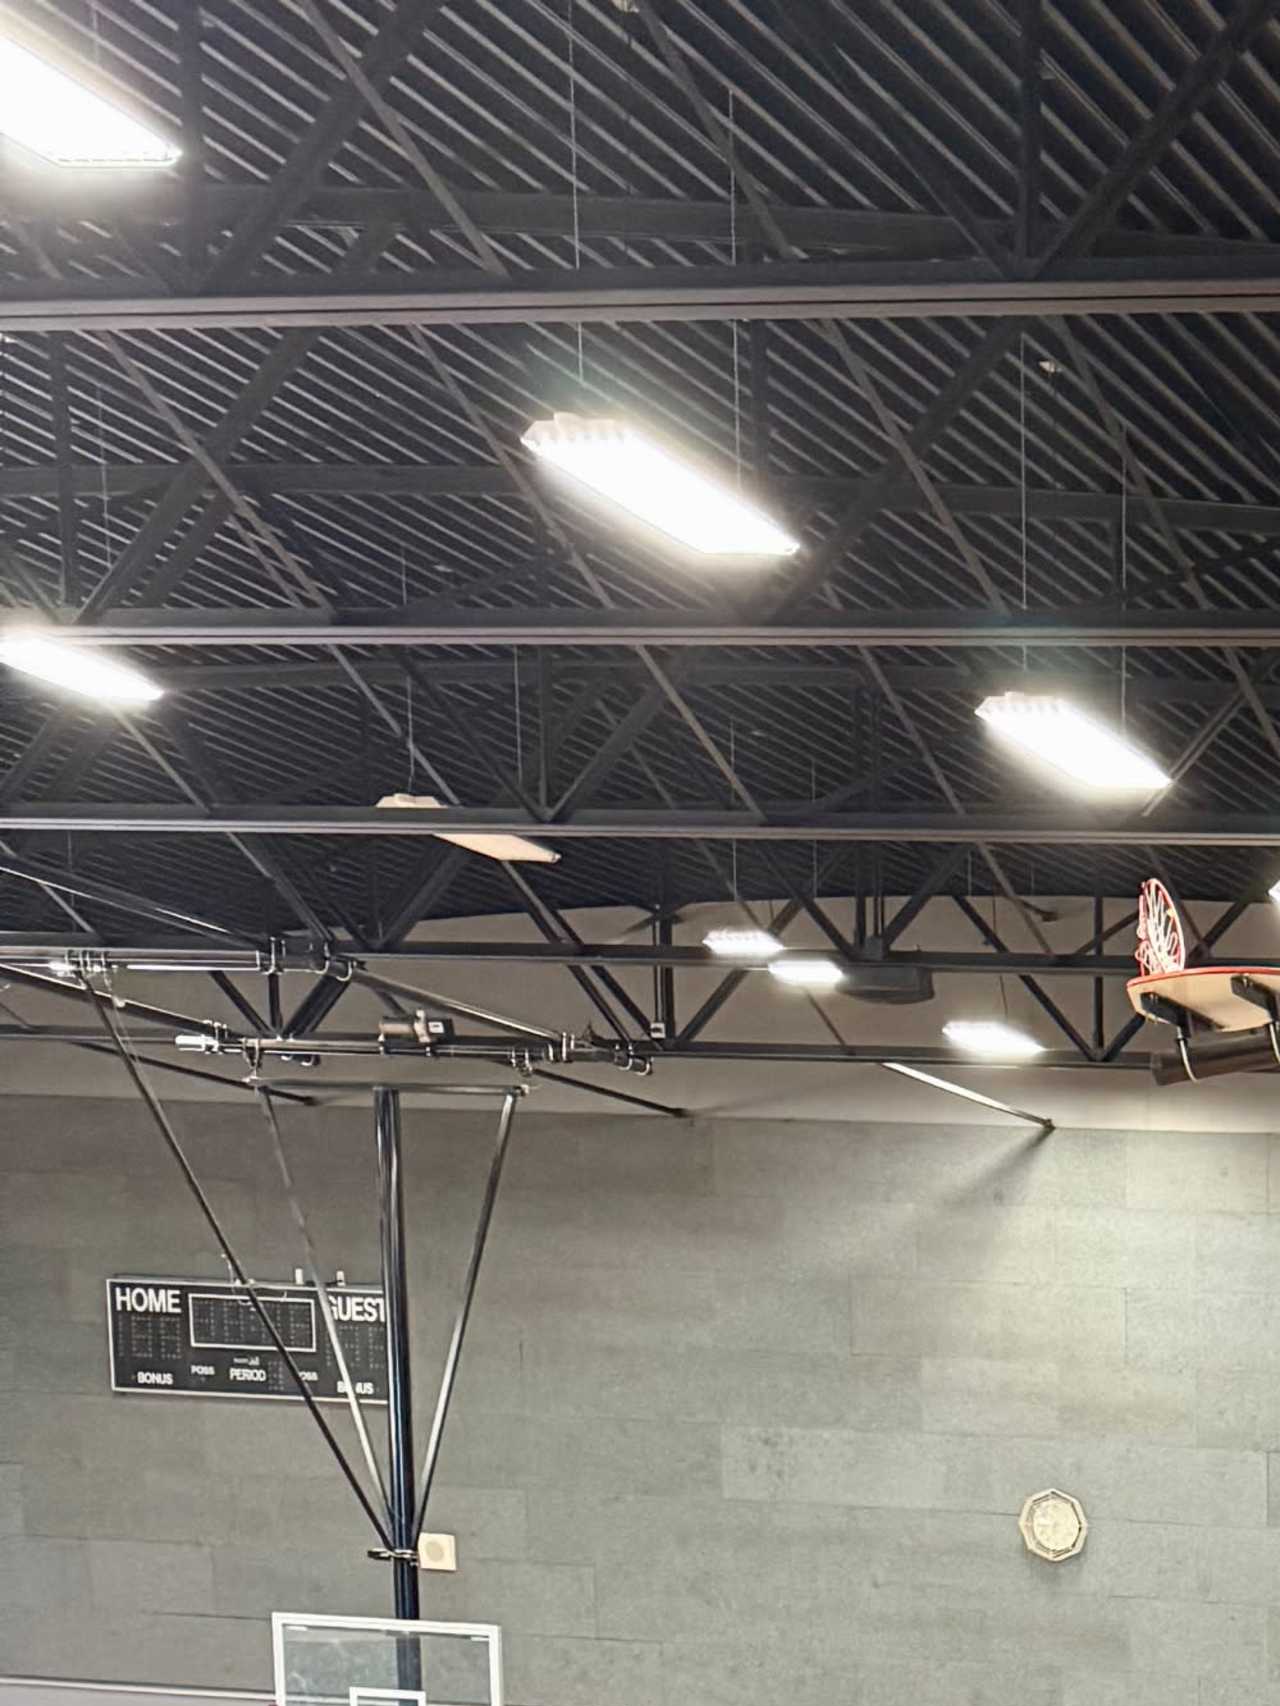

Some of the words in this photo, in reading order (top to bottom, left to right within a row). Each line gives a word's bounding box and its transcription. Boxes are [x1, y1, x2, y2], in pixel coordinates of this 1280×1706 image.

[115, 1287, 182, 1313] HOME
[137, 1371, 173, 1385] BONUS
[229, 1367, 267, 1382] PERIOD
[299, 1371, 318, 1381] OSS
[336, 1381, 374, 1394] BUS
